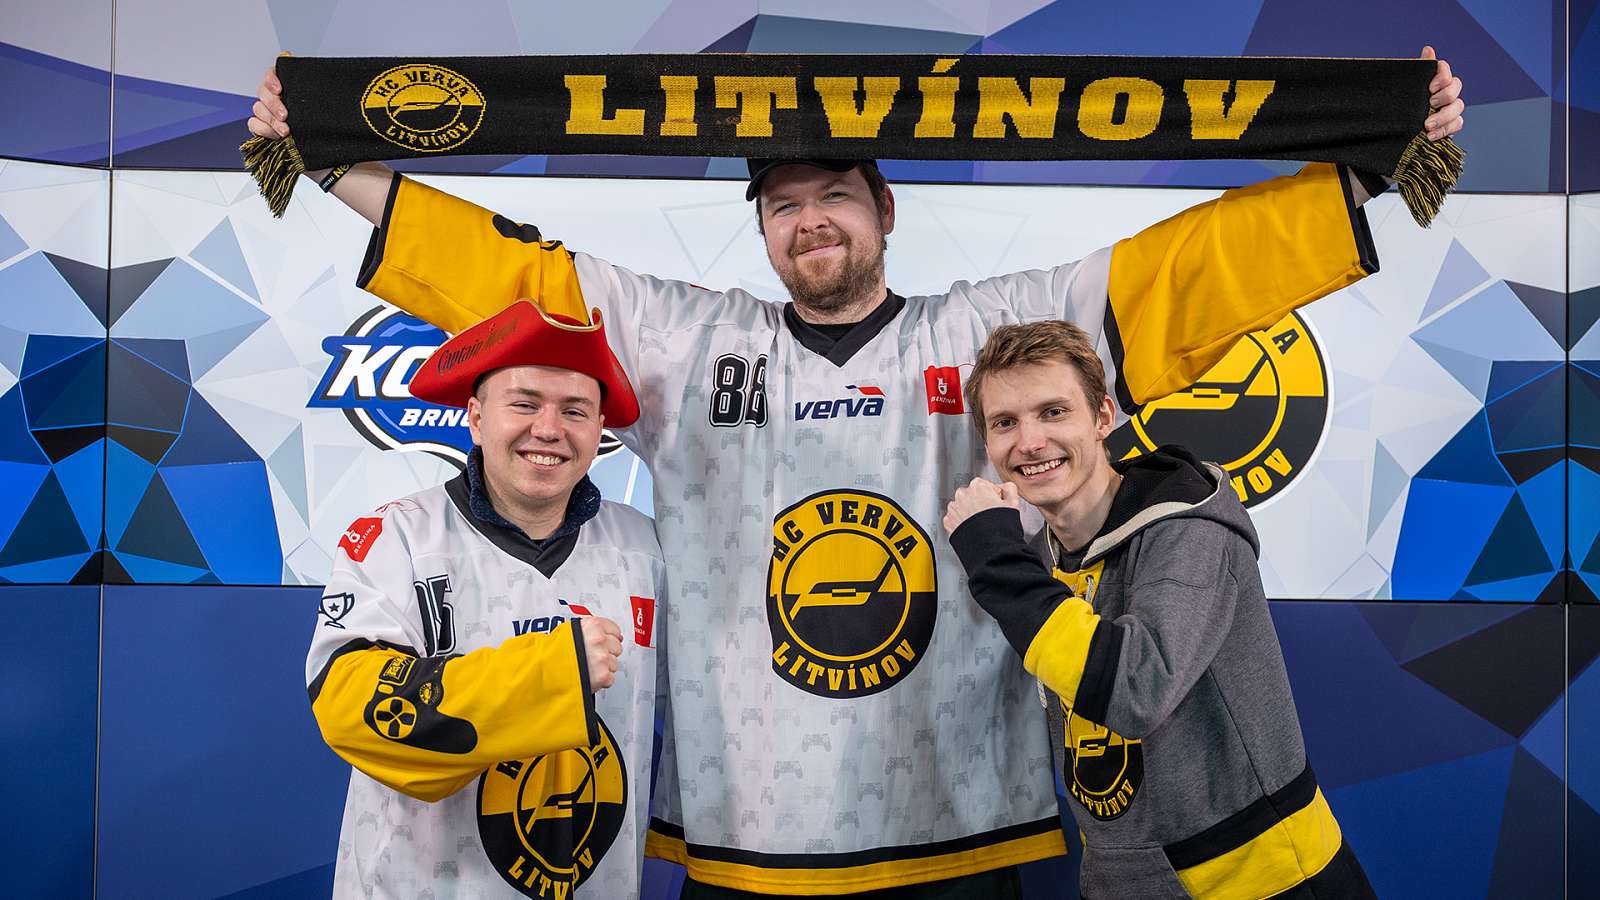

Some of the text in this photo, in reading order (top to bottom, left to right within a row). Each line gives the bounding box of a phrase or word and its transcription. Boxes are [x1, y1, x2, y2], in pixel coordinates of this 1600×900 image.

[374, 70, 469, 98] HC VERVA
[564, 58, 1276, 141] LITVÍNOV
[709, 353, 768, 428] 88
[794, 397, 886, 421] verva
[773, 500, 918, 562] HC VERVA
[772, 638, 916, 691] LITVÍNOV
